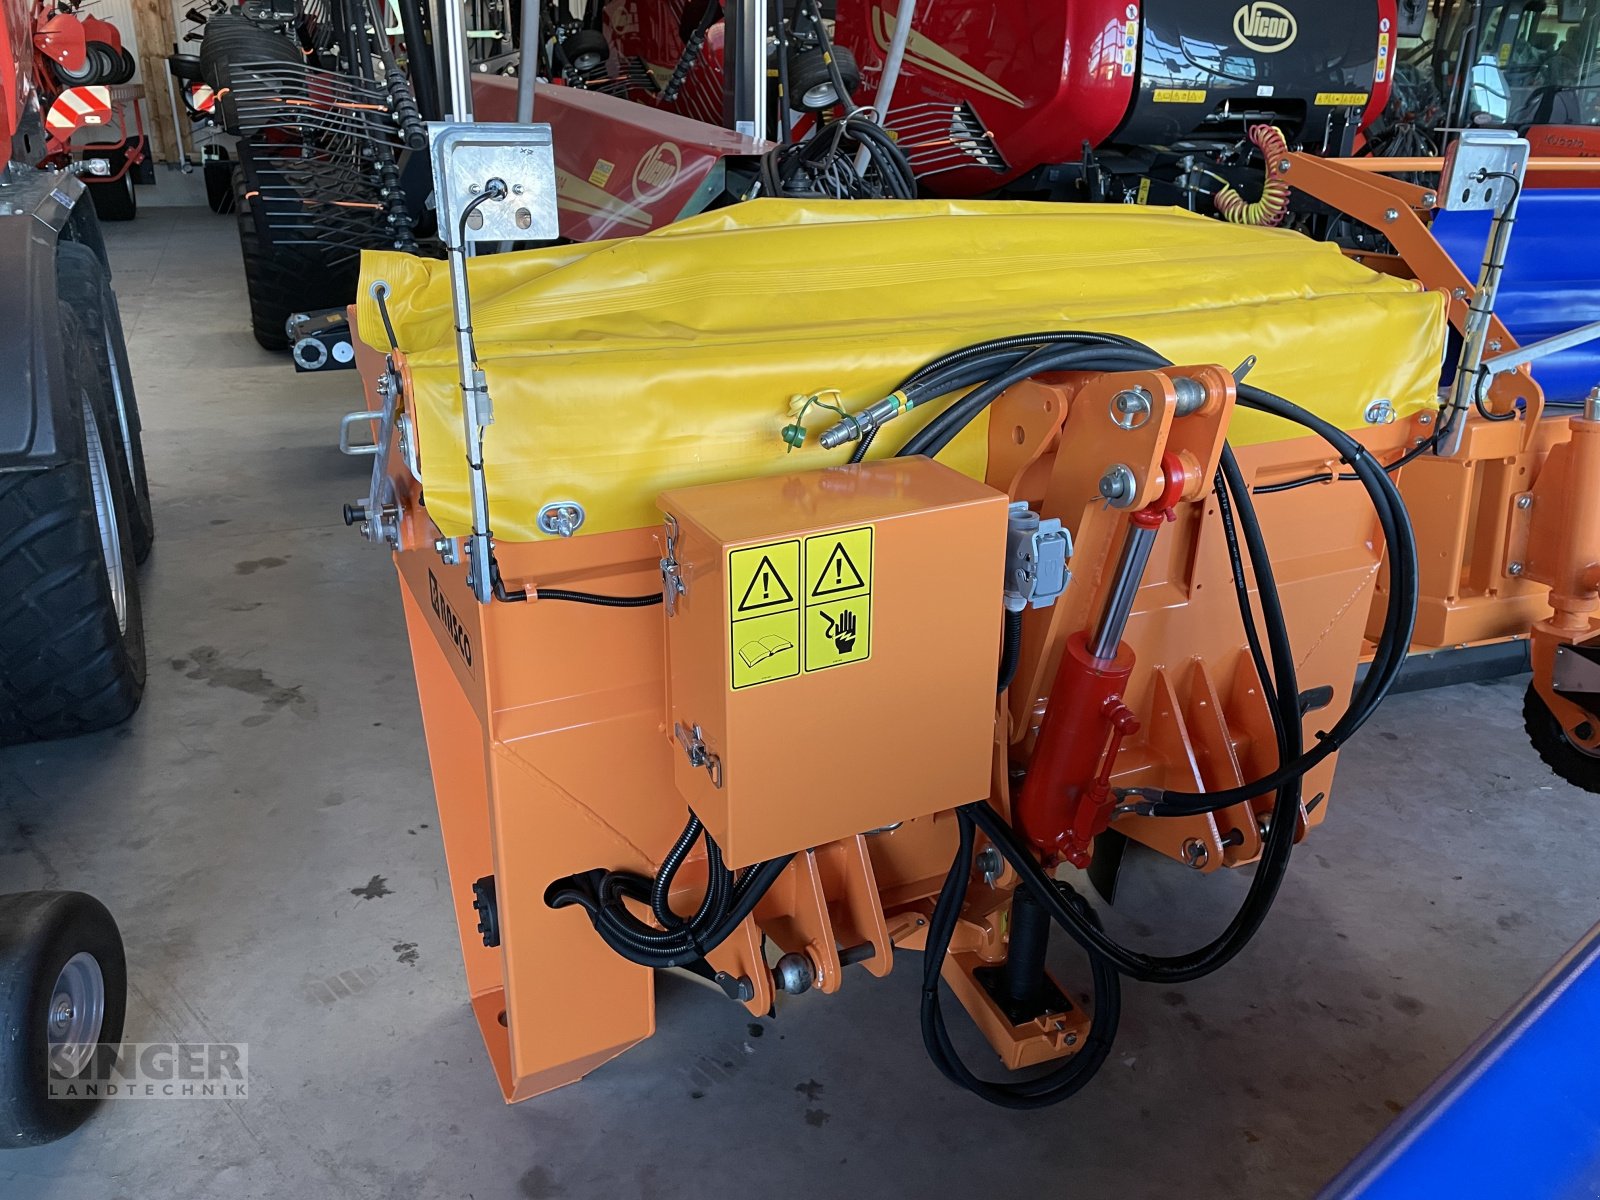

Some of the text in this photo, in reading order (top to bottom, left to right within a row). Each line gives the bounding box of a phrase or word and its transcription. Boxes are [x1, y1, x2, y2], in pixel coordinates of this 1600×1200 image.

[1238, 2, 1293, 43] Vicon
[635, 143, 678, 194] Vicon
[439, 592, 473, 668] RASCO
